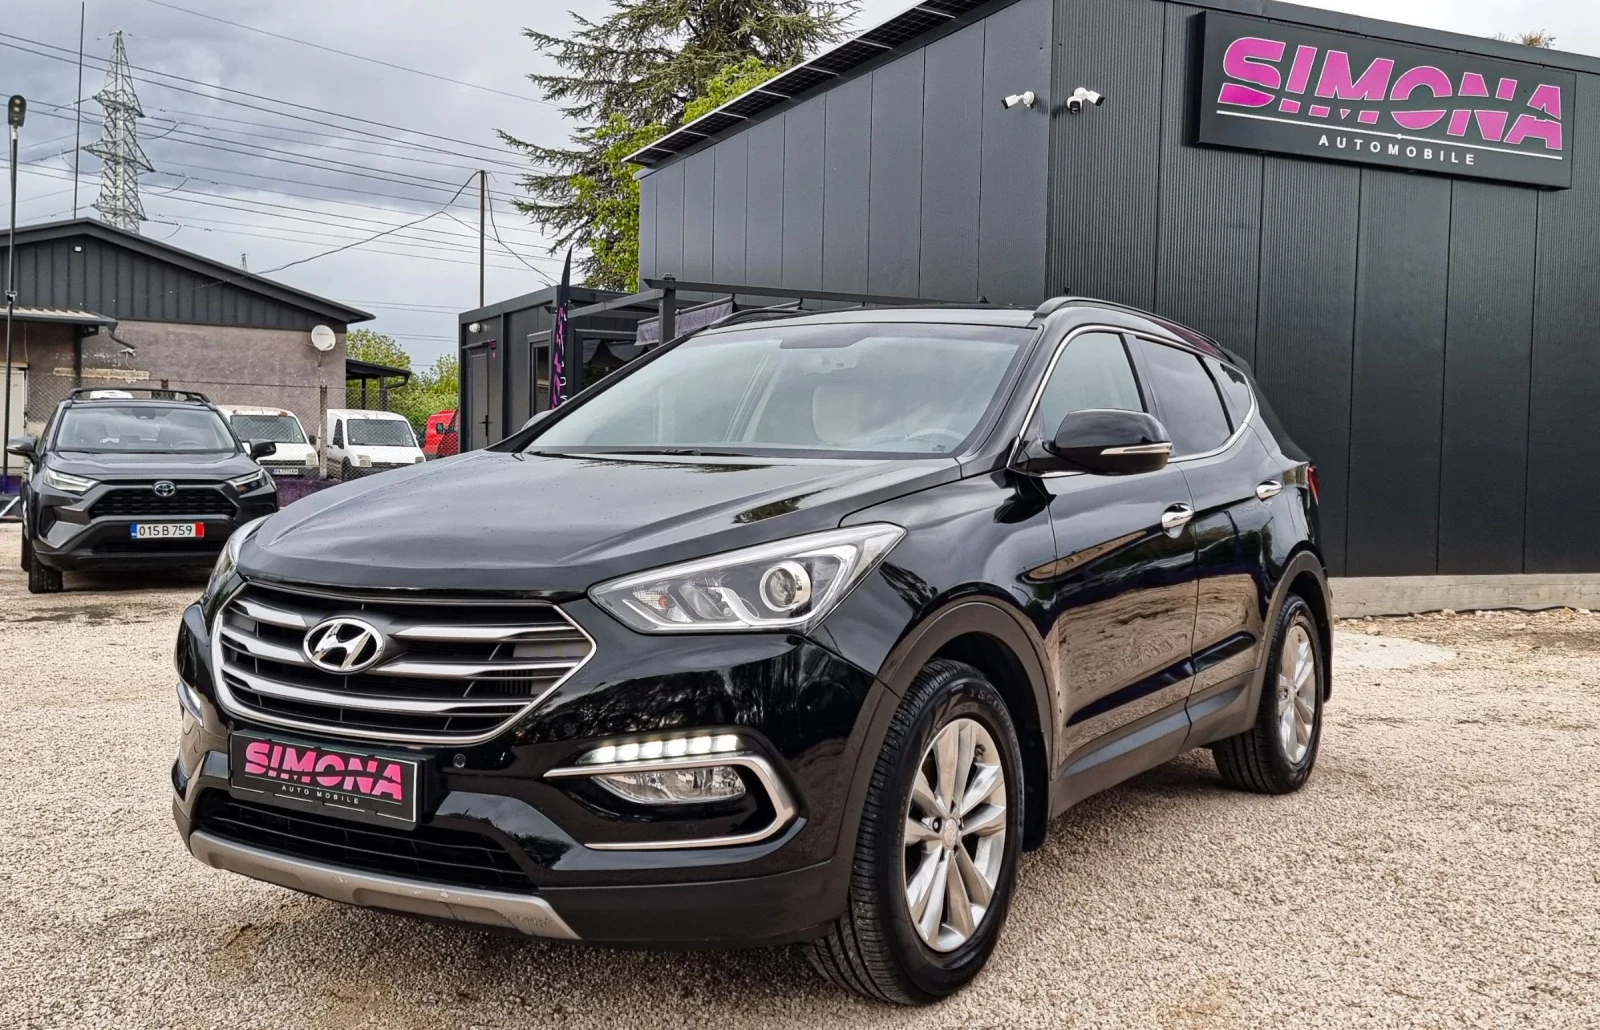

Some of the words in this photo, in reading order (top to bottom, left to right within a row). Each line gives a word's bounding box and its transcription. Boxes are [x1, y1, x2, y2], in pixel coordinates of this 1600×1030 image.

[1217, 36, 1563, 151] SIMONA
[1318, 134, 1476, 166] AUTOMOBILE
[245, 741, 403, 801] SIMONA
